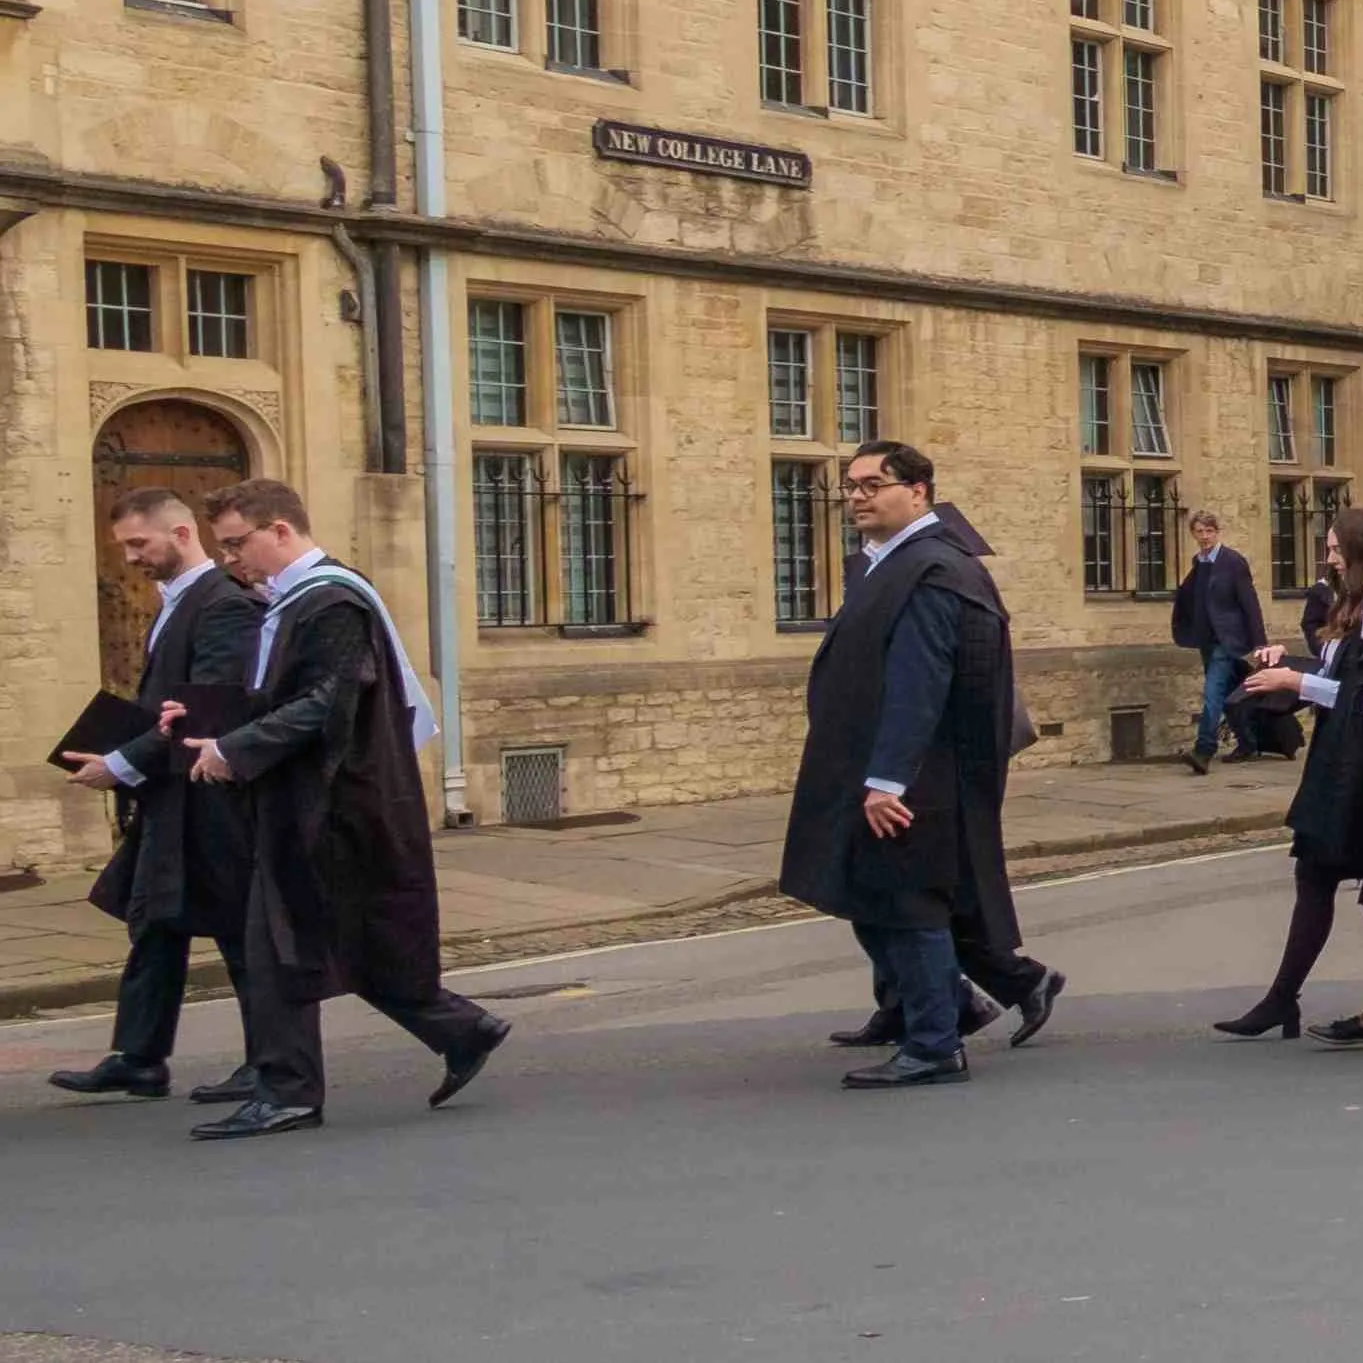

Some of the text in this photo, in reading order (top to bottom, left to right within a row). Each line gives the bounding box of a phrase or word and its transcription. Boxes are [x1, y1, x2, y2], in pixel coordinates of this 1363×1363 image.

[608, 129, 802, 178] NEW COLLEGE LANE
